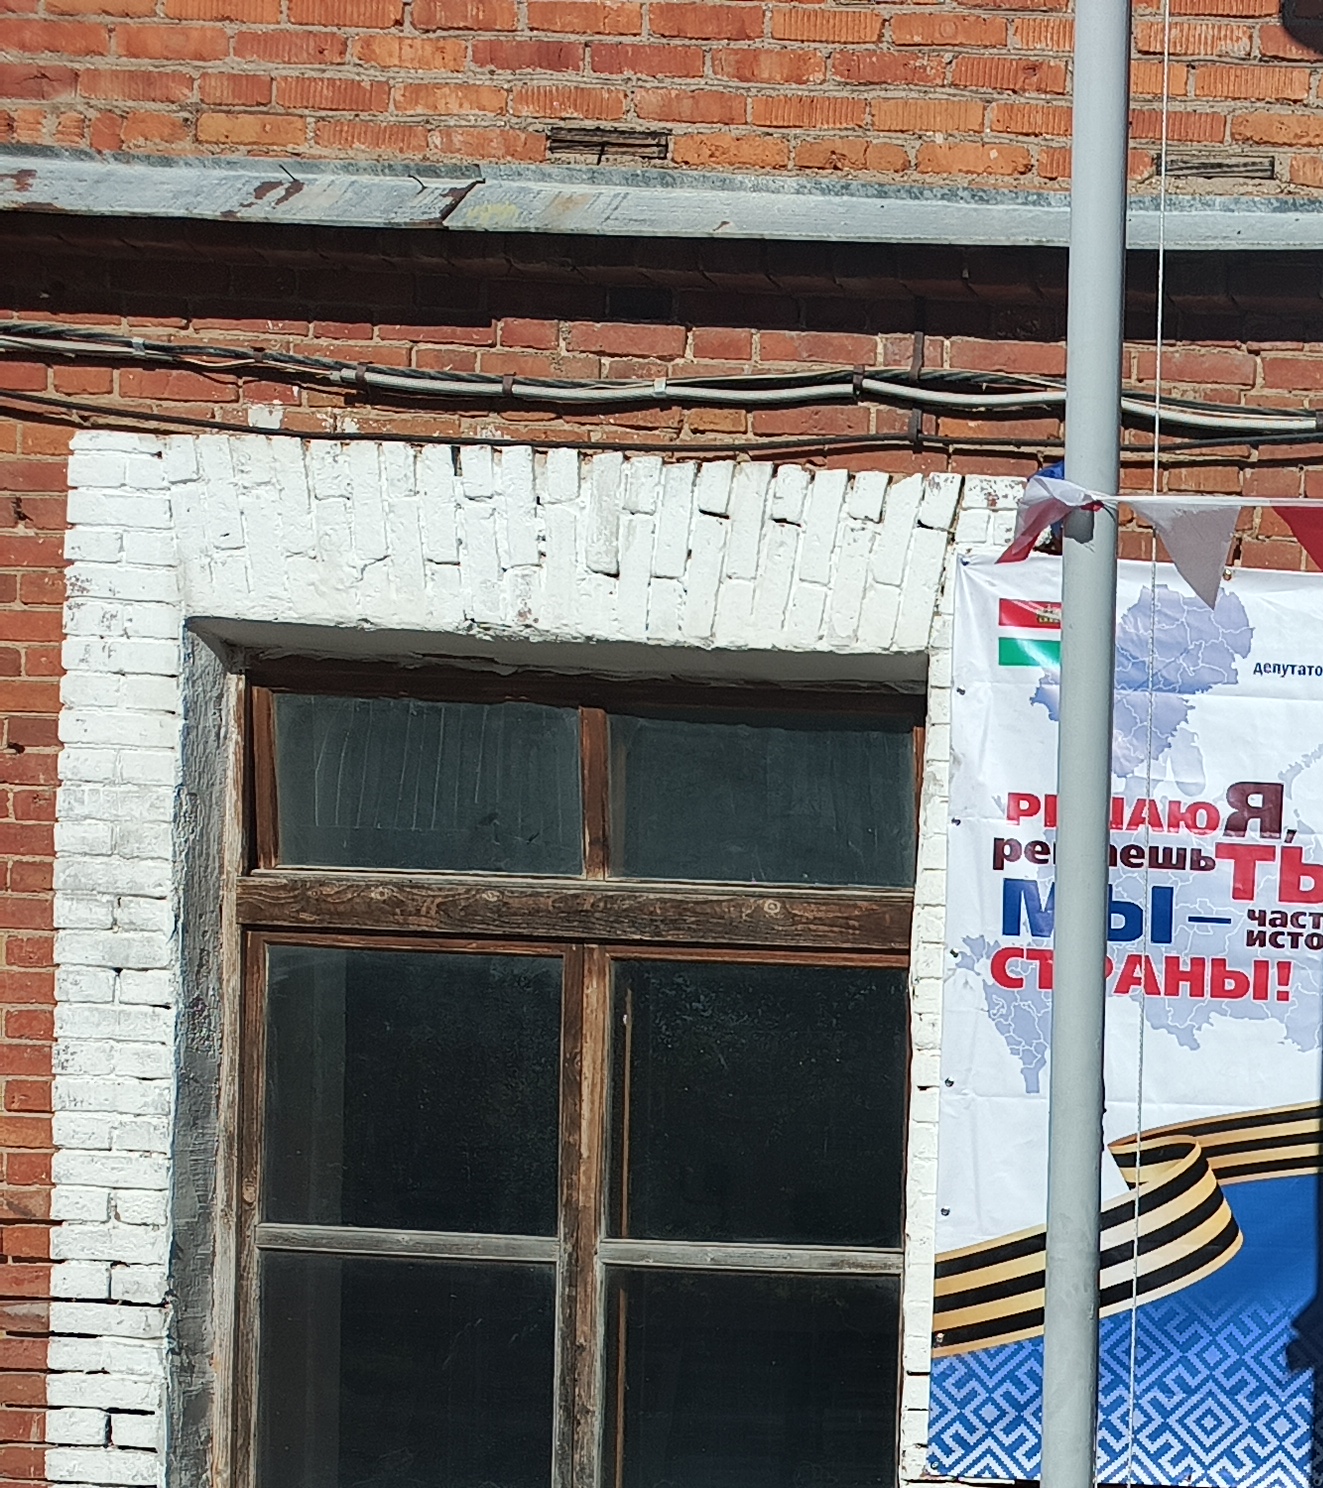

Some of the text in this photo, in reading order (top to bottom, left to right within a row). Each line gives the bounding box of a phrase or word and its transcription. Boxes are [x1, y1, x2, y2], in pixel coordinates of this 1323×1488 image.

[1006, 781, 1297, 842] РАЮ Я,
[990, 946, 1292, 1002] СТАНЫ!
